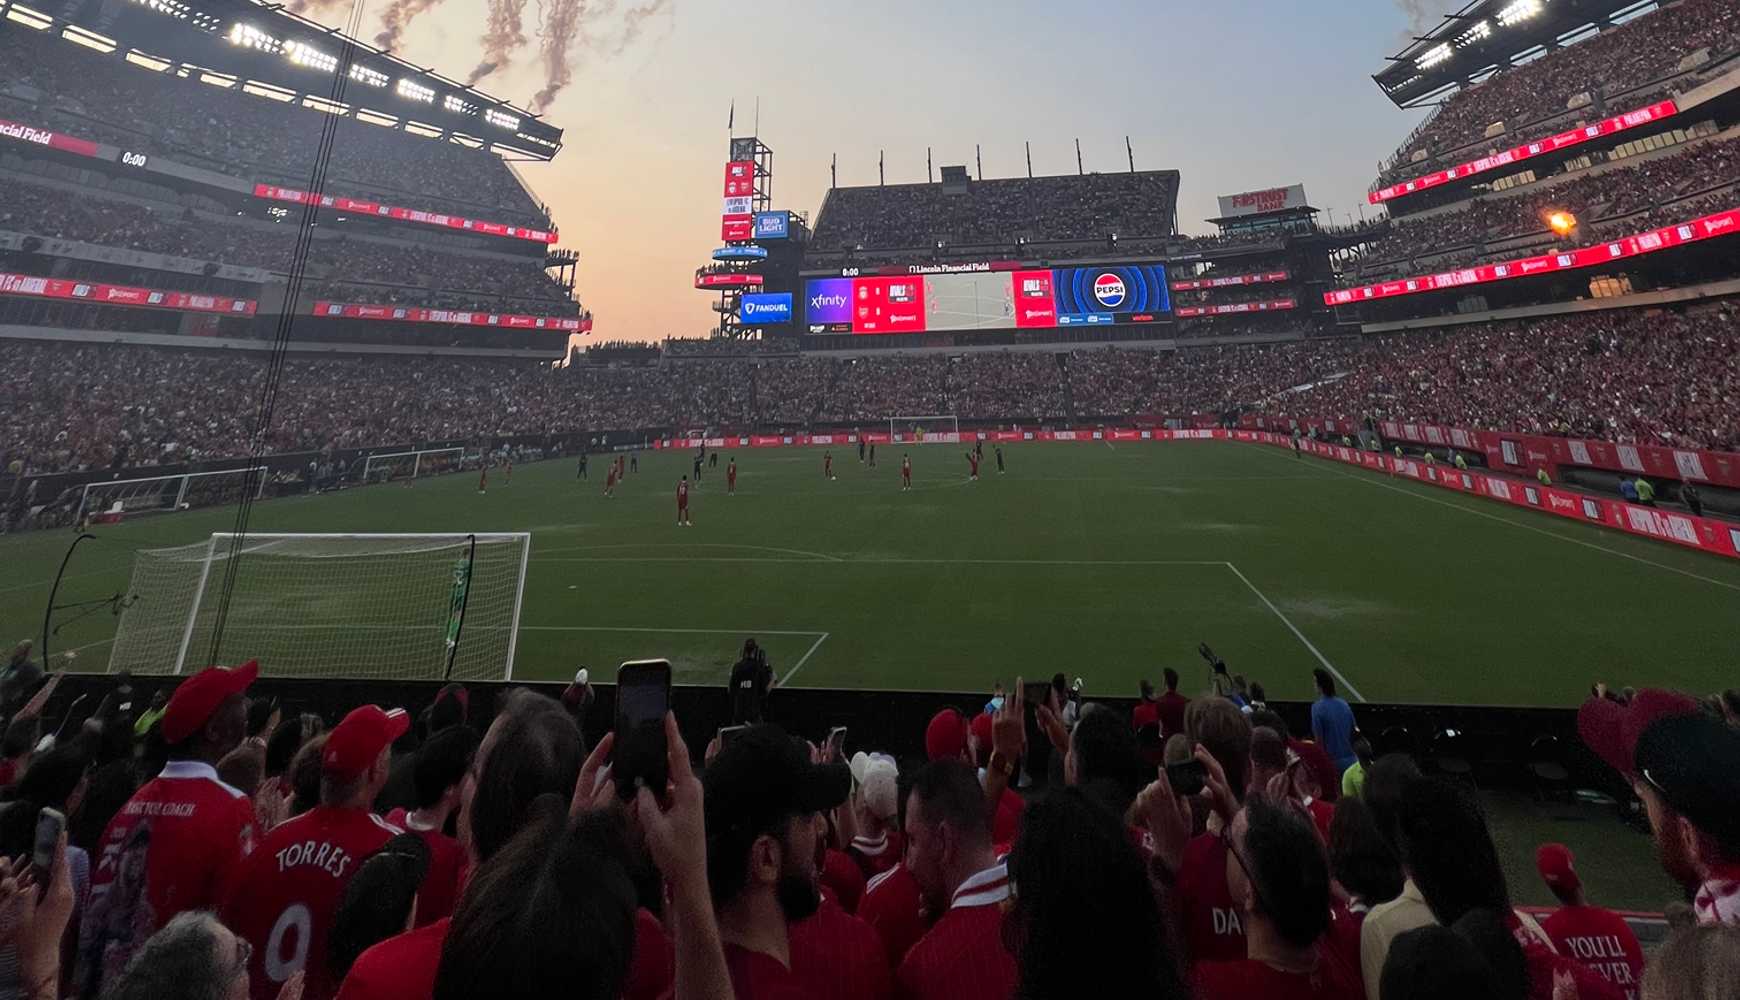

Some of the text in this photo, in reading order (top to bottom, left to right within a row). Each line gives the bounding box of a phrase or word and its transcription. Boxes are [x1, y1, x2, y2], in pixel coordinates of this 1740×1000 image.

[23, 127, 52, 145] Field
[122, 152, 146, 166] 0:00
[1256, 200, 1285, 212] BANK
[843, 268, 859, 276] 0:00
[916, 262, 990, 273] Lincoln Financial Field
[1096, 285, 1124, 294] PEPSI
[755, 304, 788, 312] FANDUEL
[811, 294, 847, 309] xfinity
[276, 841, 350, 878] TORRES
[1565, 935, 1627, 958] YOU'LL
